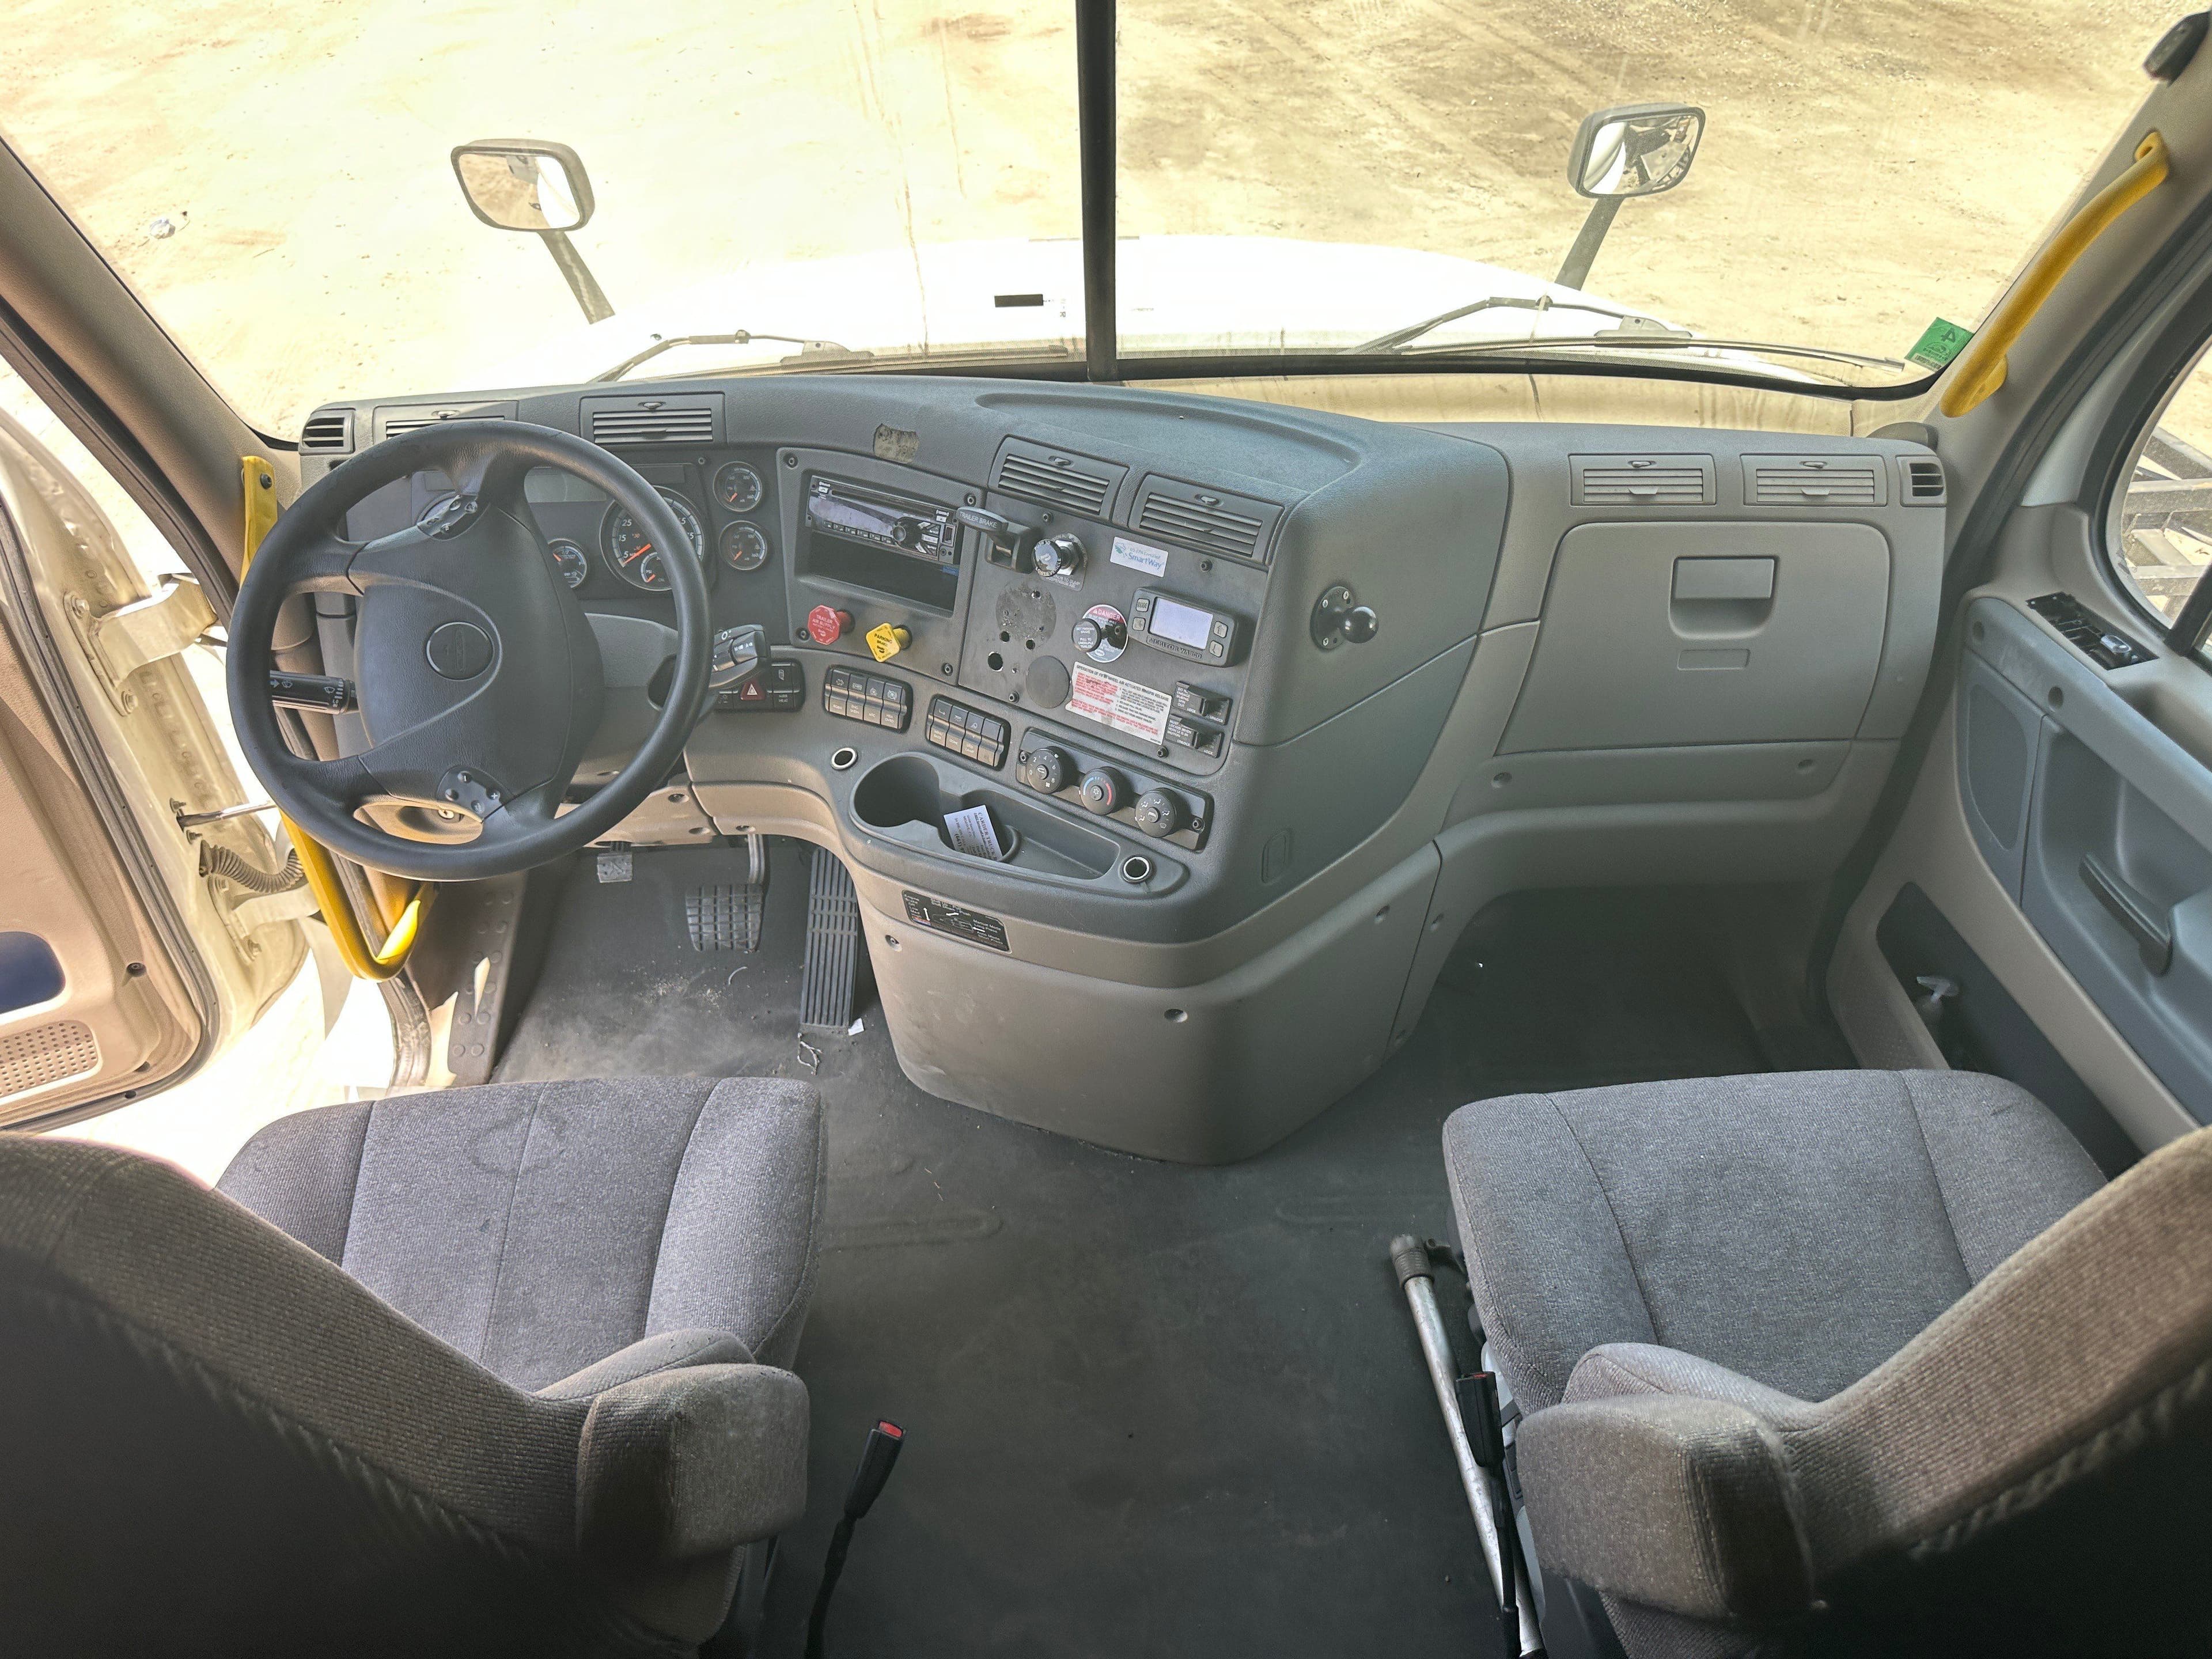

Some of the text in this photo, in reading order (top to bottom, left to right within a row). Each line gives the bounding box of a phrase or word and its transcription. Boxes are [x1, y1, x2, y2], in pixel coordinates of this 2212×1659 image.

[959, 512, 979, 522] TRAILER
[979, 518, 997, 528] BRAKE
[1128, 552, 1162, 570] SmartWay
[816, 615, 832, 623] TRAILER
[1099, 609, 1120, 620] DANGER
[874, 633, 892, 643] PARKING
[1149, 638, 1202, 659] MERITOR WABCO
[1076, 665, 1094, 675] OPERATION
[1124, 682, 1142, 691] ACTUATED
[953, 833, 963, 847] (661)
[976, 812, 990, 836] CARDER
[986, 836, 997, 855] TRUCK
